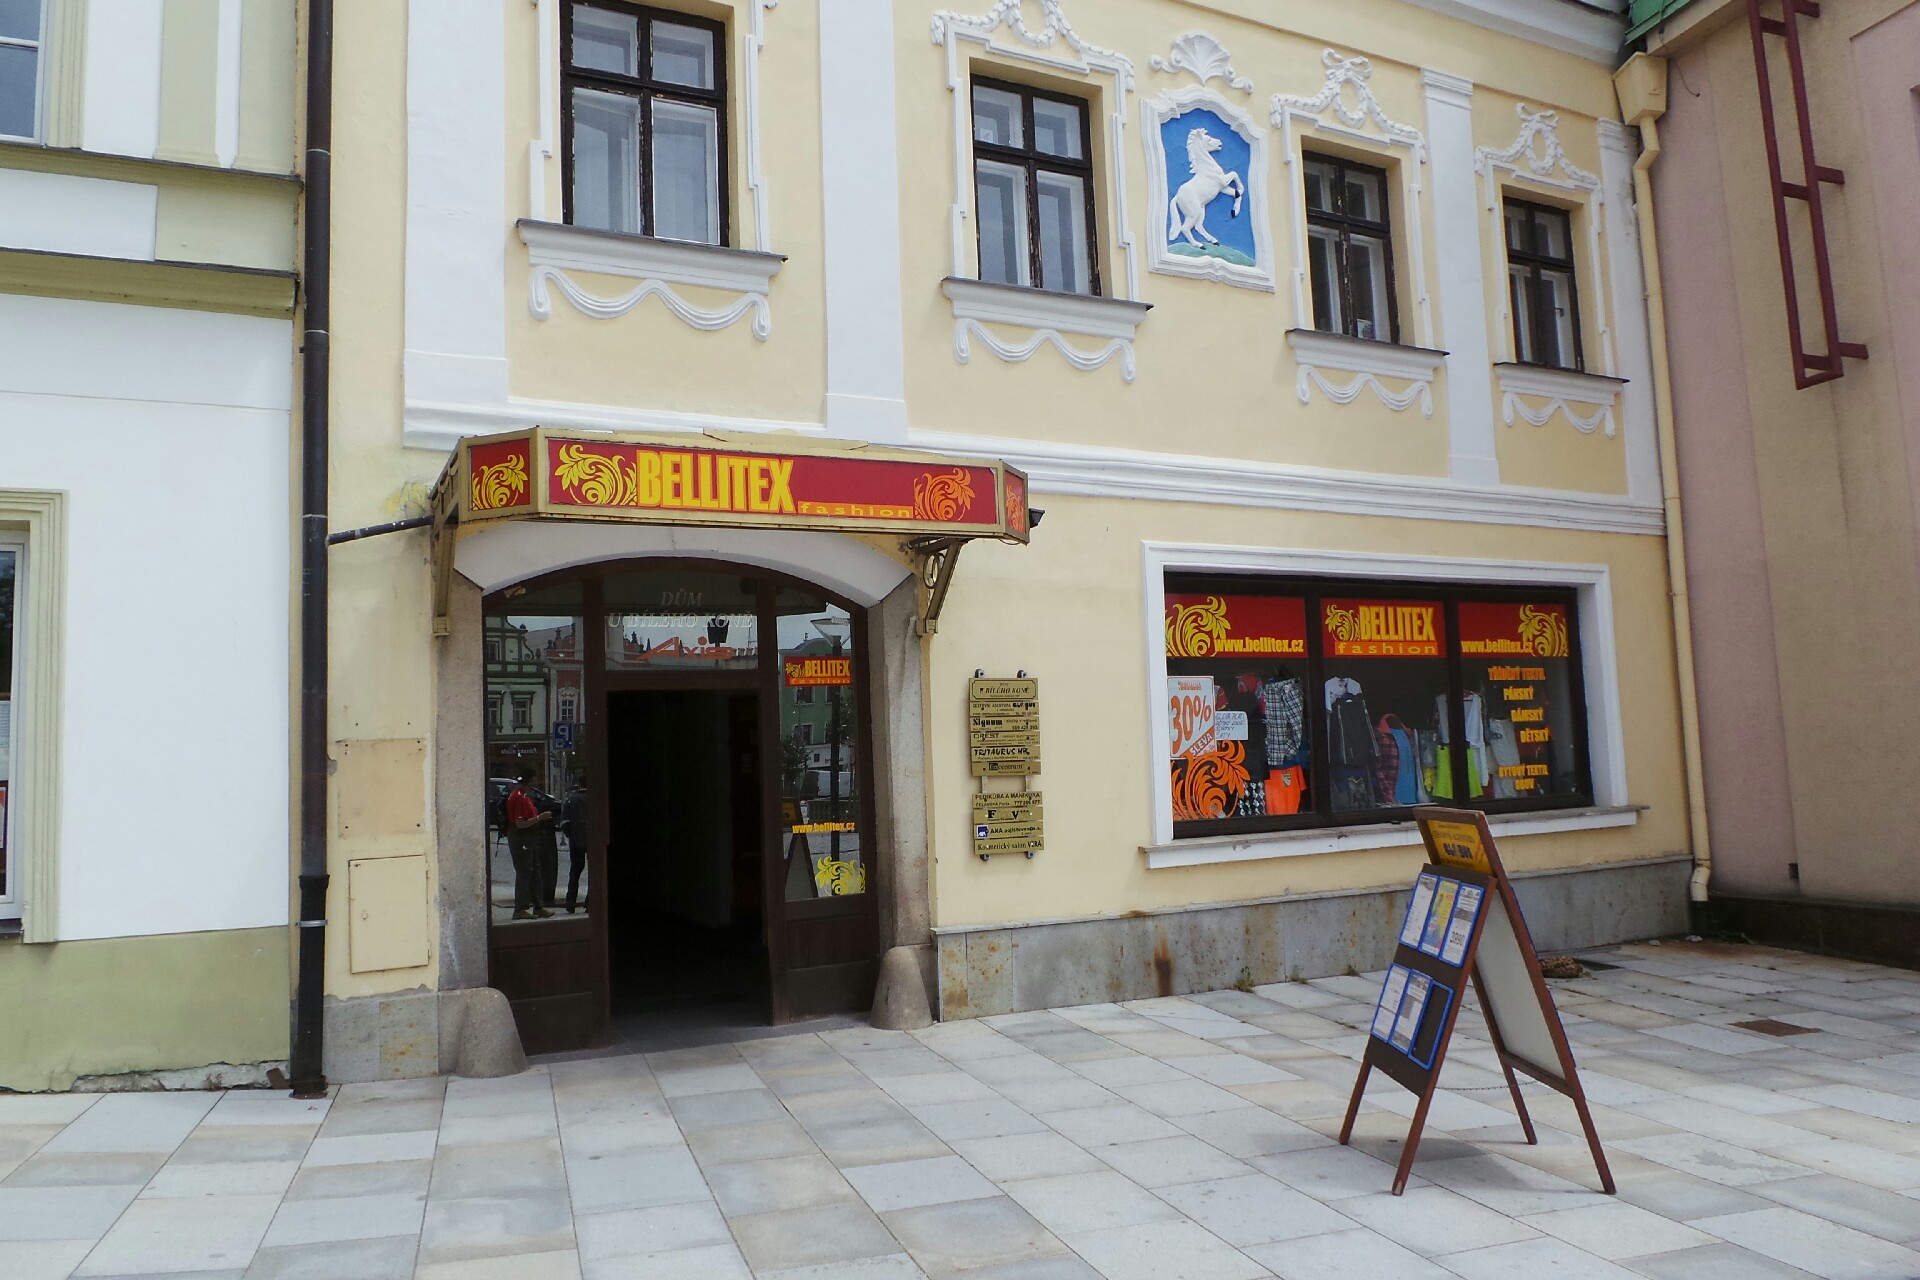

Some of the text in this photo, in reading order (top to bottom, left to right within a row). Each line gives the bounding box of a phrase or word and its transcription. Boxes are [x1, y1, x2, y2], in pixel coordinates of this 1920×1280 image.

[637, 450, 797, 514] BELLITEX
[800, 502, 912, 518] fashion
[660, 588, 704, 606] DŮM
[608, 609, 753, 629] U BÍLÉHO KONĚ
[1358, 606, 1436, 641] BELLITEX
[1214, 636, 1304, 653] www.bellitex.cz
[1337, 642, 1436, 655] fashion
[1461, 638, 1534, 654] www.bellitex.cz
[804, 659, 850, 677] BELLITEX
[1503, 686, 1534, 701] PÁNSKÝ
[973, 718, 1002, 727] Signum
[1510, 707, 1544, 722] DÁMSKÝ
[1171, 695, 1212, 754] 30%
[1520, 728, 1549, 743] DĚTSKÝ
[1189, 733, 1213, 756] SLEVA
[1526, 764, 1549, 776] TEXTIL
[988, 810, 996, 818] F
[792, 822, 856, 834] www.bellitex.cz
[977, 842, 1011, 851] Kosmetický
